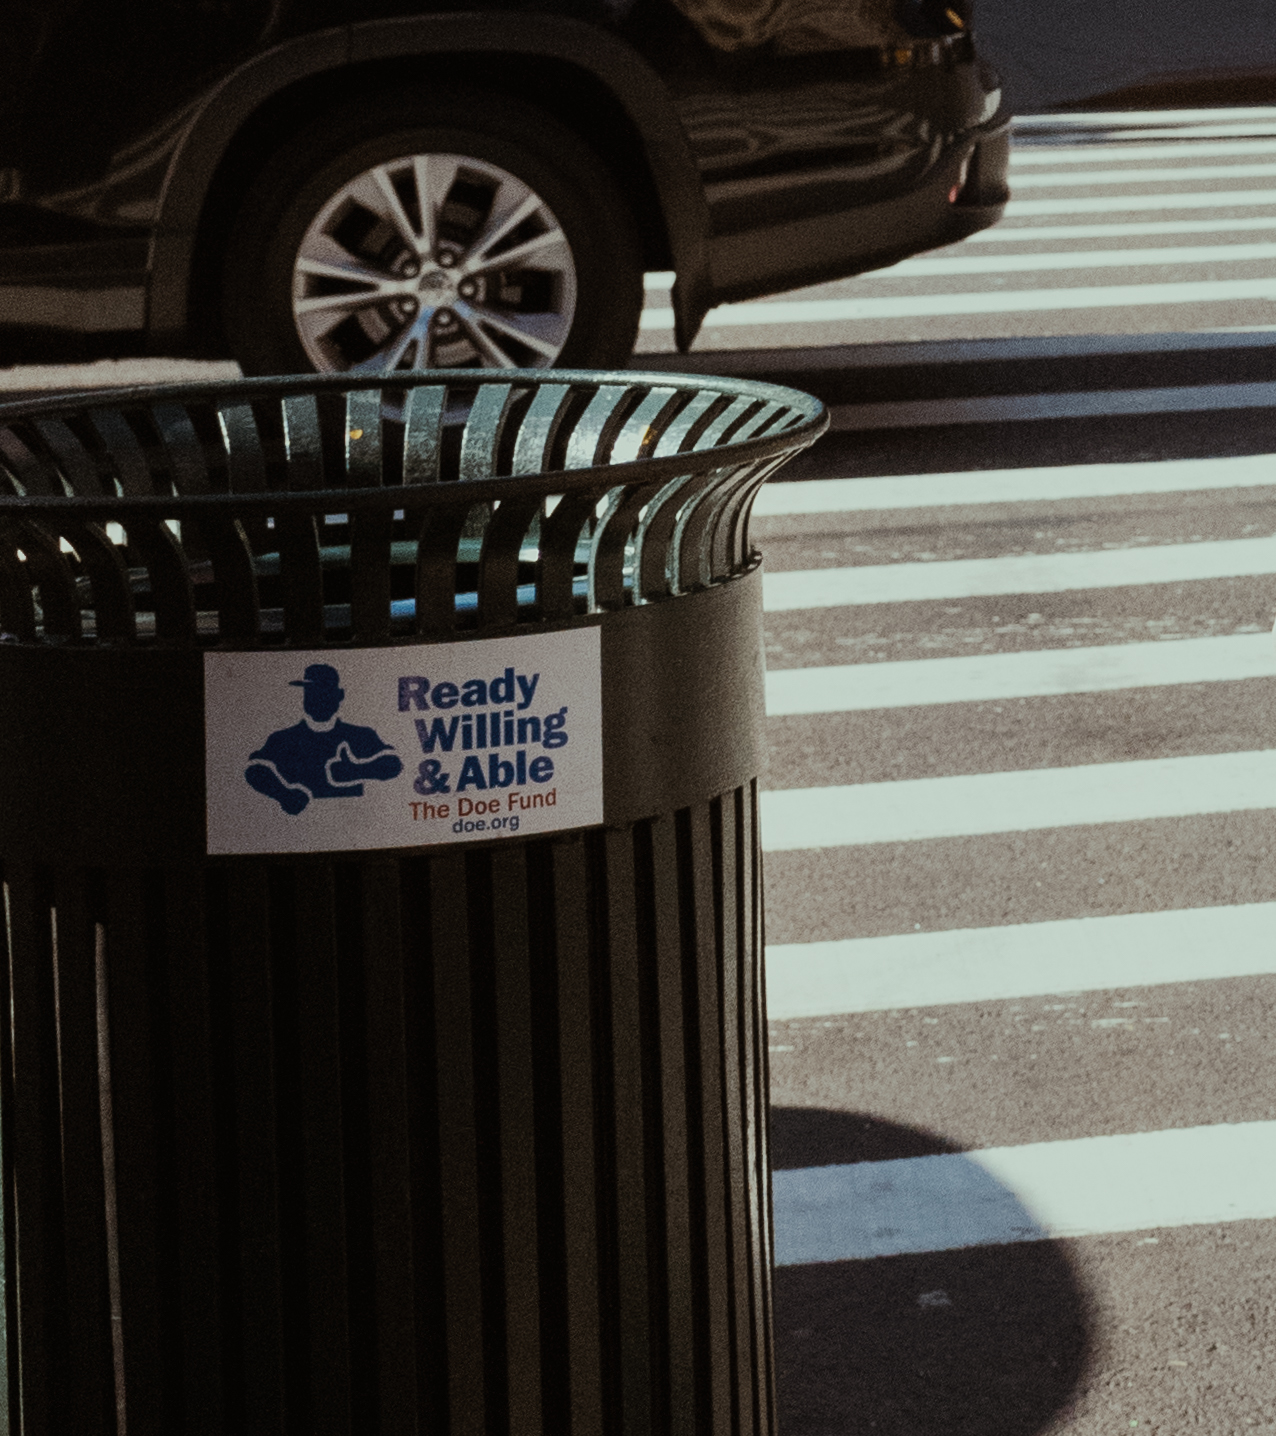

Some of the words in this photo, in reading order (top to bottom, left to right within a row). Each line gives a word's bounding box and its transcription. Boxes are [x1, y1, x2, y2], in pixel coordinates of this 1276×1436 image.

[397, 667, 540, 712] Ready
[414, 706, 569, 753] Willing
[413, 758, 451, 796] &
[455, 750, 554, 792] Able
[409, 801, 450, 820] The
[458, 797, 500, 817] Doe
[507, 788, 556, 811] Fund
[452, 815, 520, 833] doe.org
